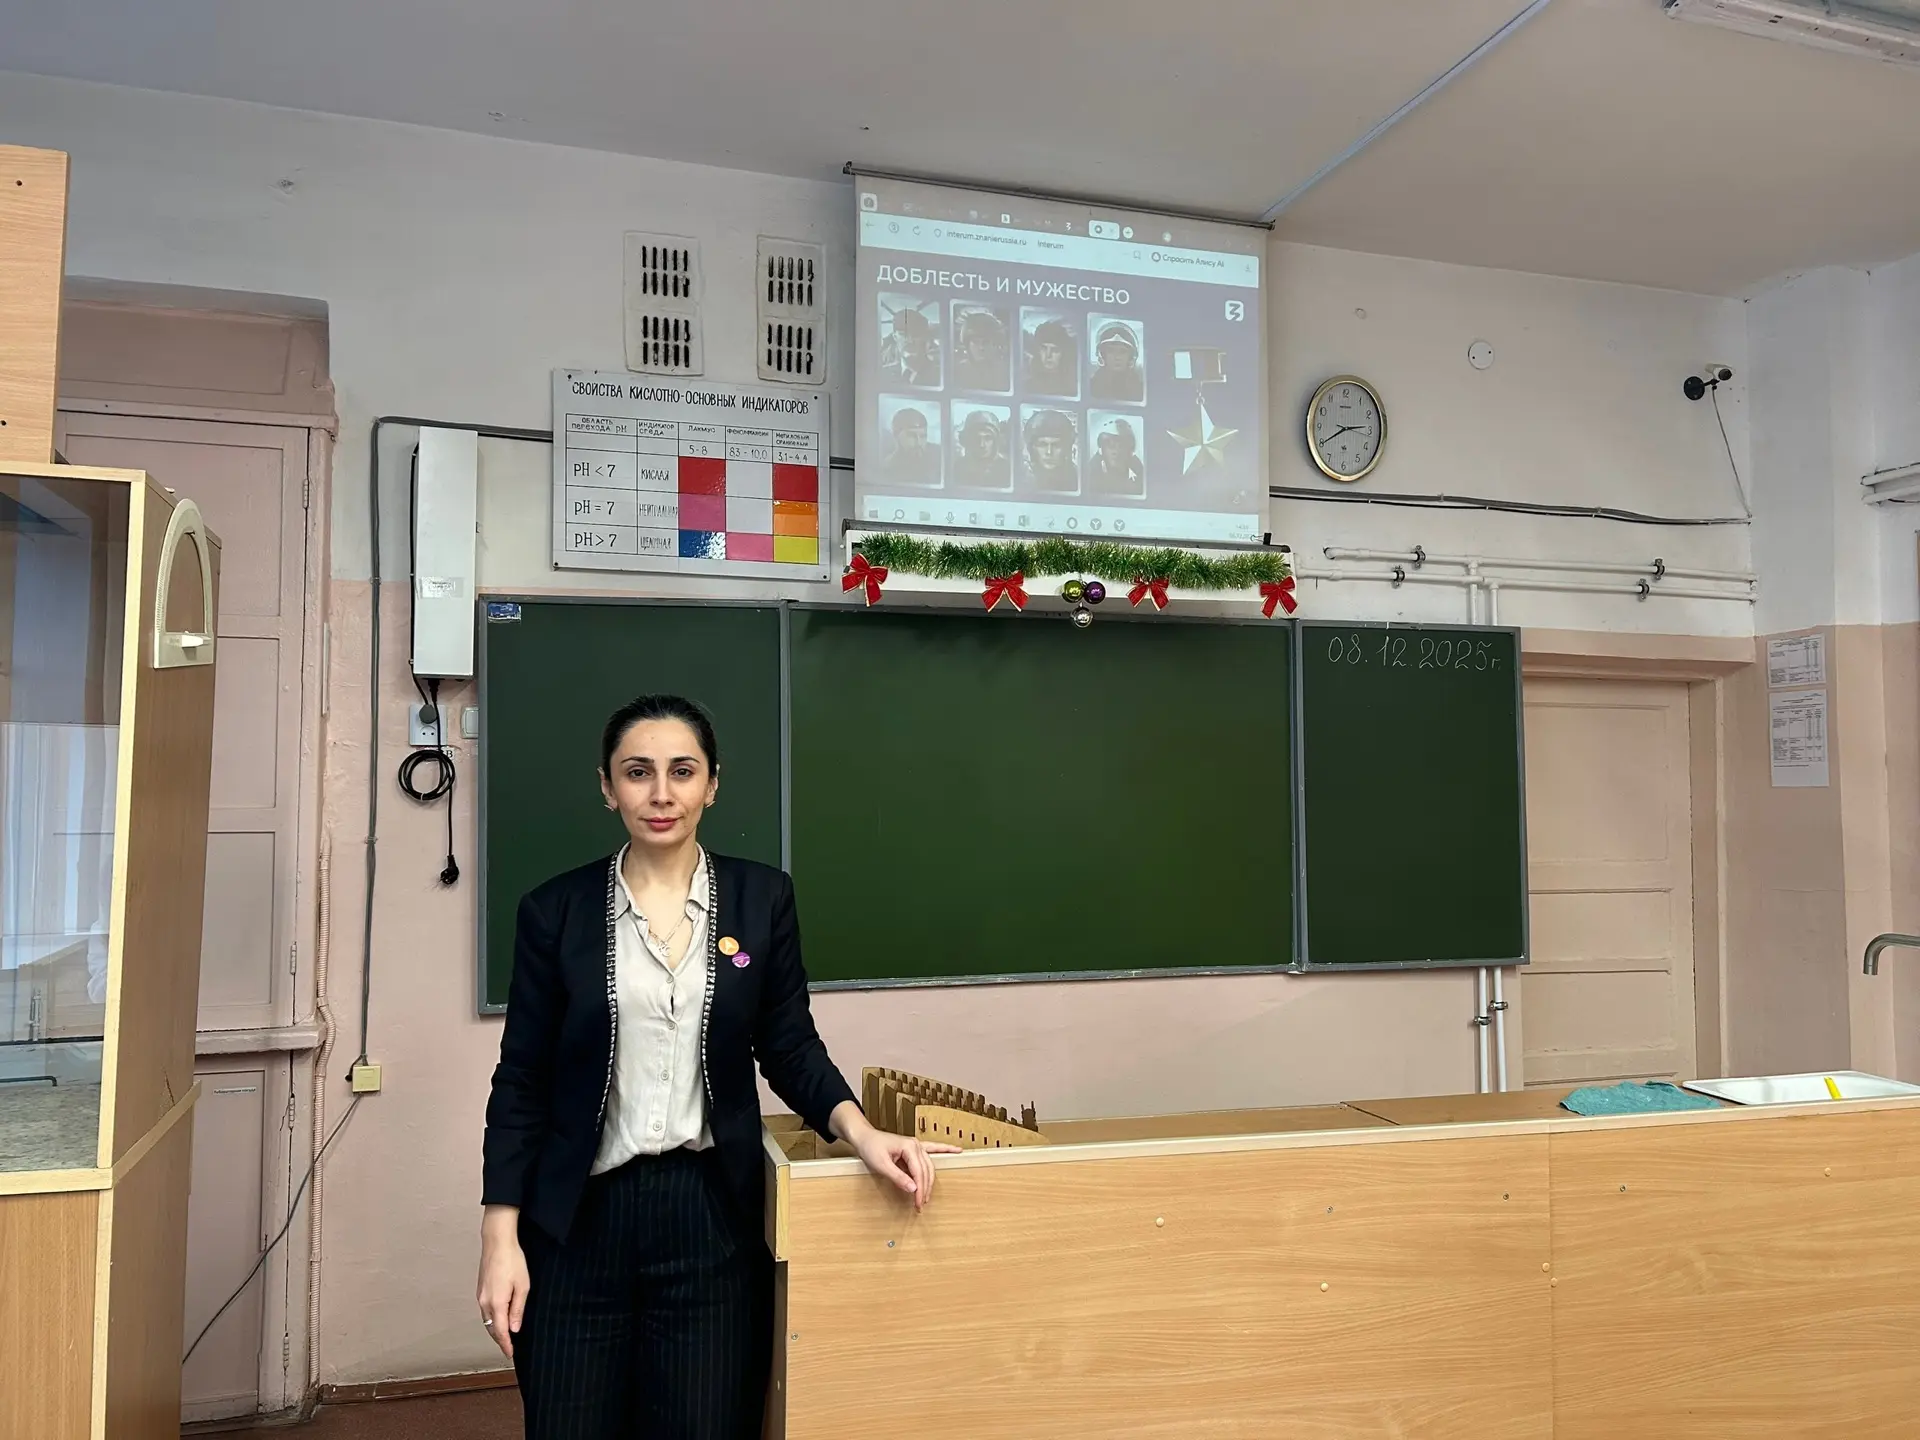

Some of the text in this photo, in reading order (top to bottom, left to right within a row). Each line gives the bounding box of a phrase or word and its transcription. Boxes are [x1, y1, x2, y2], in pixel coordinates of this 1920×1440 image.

[876, 264, 1131, 305] ДОБЛЕСТЬ И МУЖЕСТВО
[572, 381, 809, 415] СВОЙСТВА КИСЛОТНО-ОСНОВНЫХ ИНДИКАТОРОВ
[1343, 388, 1350, 399] 12
[1320, 406, 1328, 417] 10
[1366, 409, 1373, 420] 2
[581, 417, 614, 426] ОБЛАСТЬ
[638, 421, 675, 430] ИНДИКАТОР
[1317, 422, 1322, 431] 9
[1367, 425, 1373, 436] 3
[1363, 441, 1369, 451] 4
[1327, 453, 1332, 462] 7
[1355, 453, 1361, 463] 5
[607, 464, 616, 477] 7
[1341, 461, 1347, 471] 6
[641, 468, 670, 481] КИСЛАЯ
[606, 501, 615, 515] 7
[608, 533, 617, 547] 7
